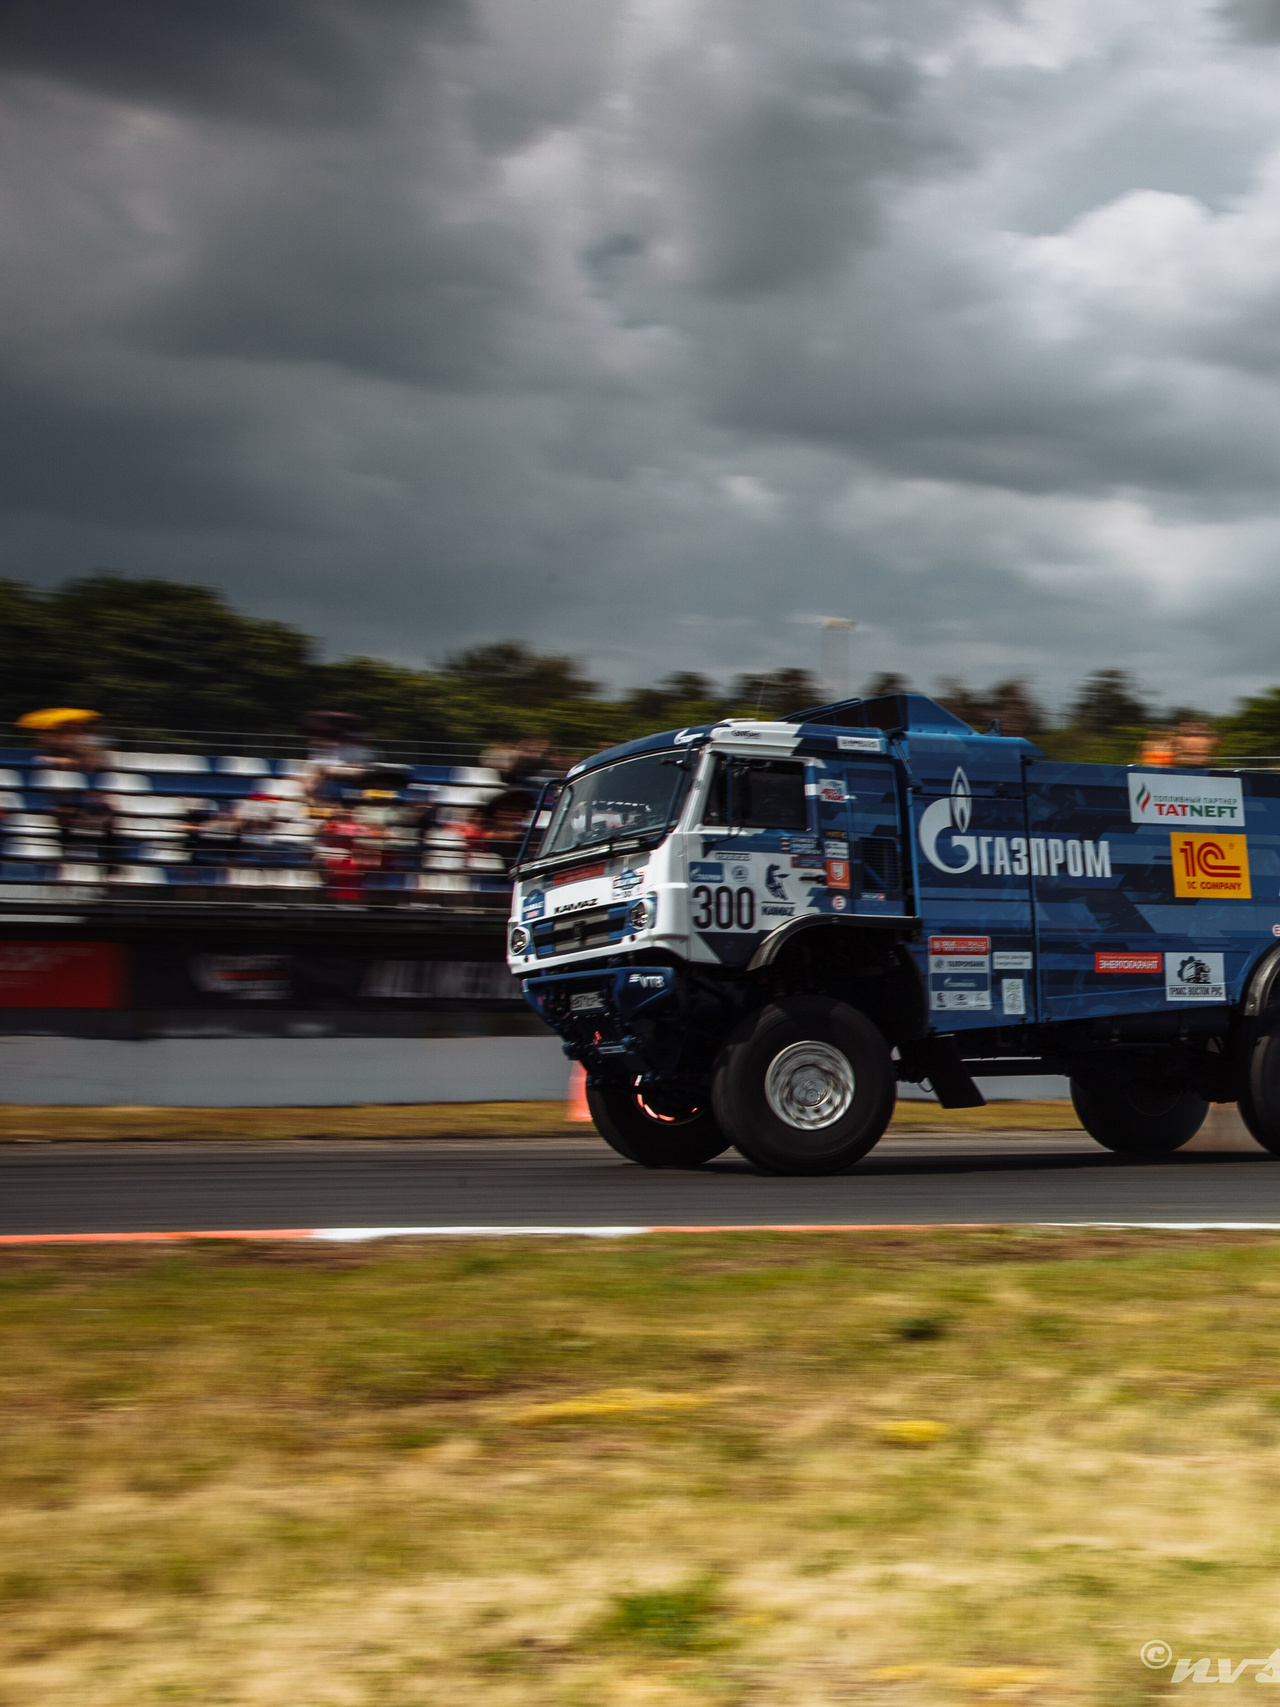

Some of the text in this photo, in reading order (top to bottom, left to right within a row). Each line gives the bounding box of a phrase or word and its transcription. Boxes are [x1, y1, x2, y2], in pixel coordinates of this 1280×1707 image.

[1153, 795, 1201, 804] ТОПЛИВНЫЙ
[1154, 803, 1238, 818] TATNEFT
[979, 836, 1112, 878] ГАЗПРОМ
[1200, 882, 1242, 890] COMPANY
[554, 898, 599, 914] KAMAZ
[693, 885, 755, 929] 300
[761, 906, 795, 916] KAMAZ
